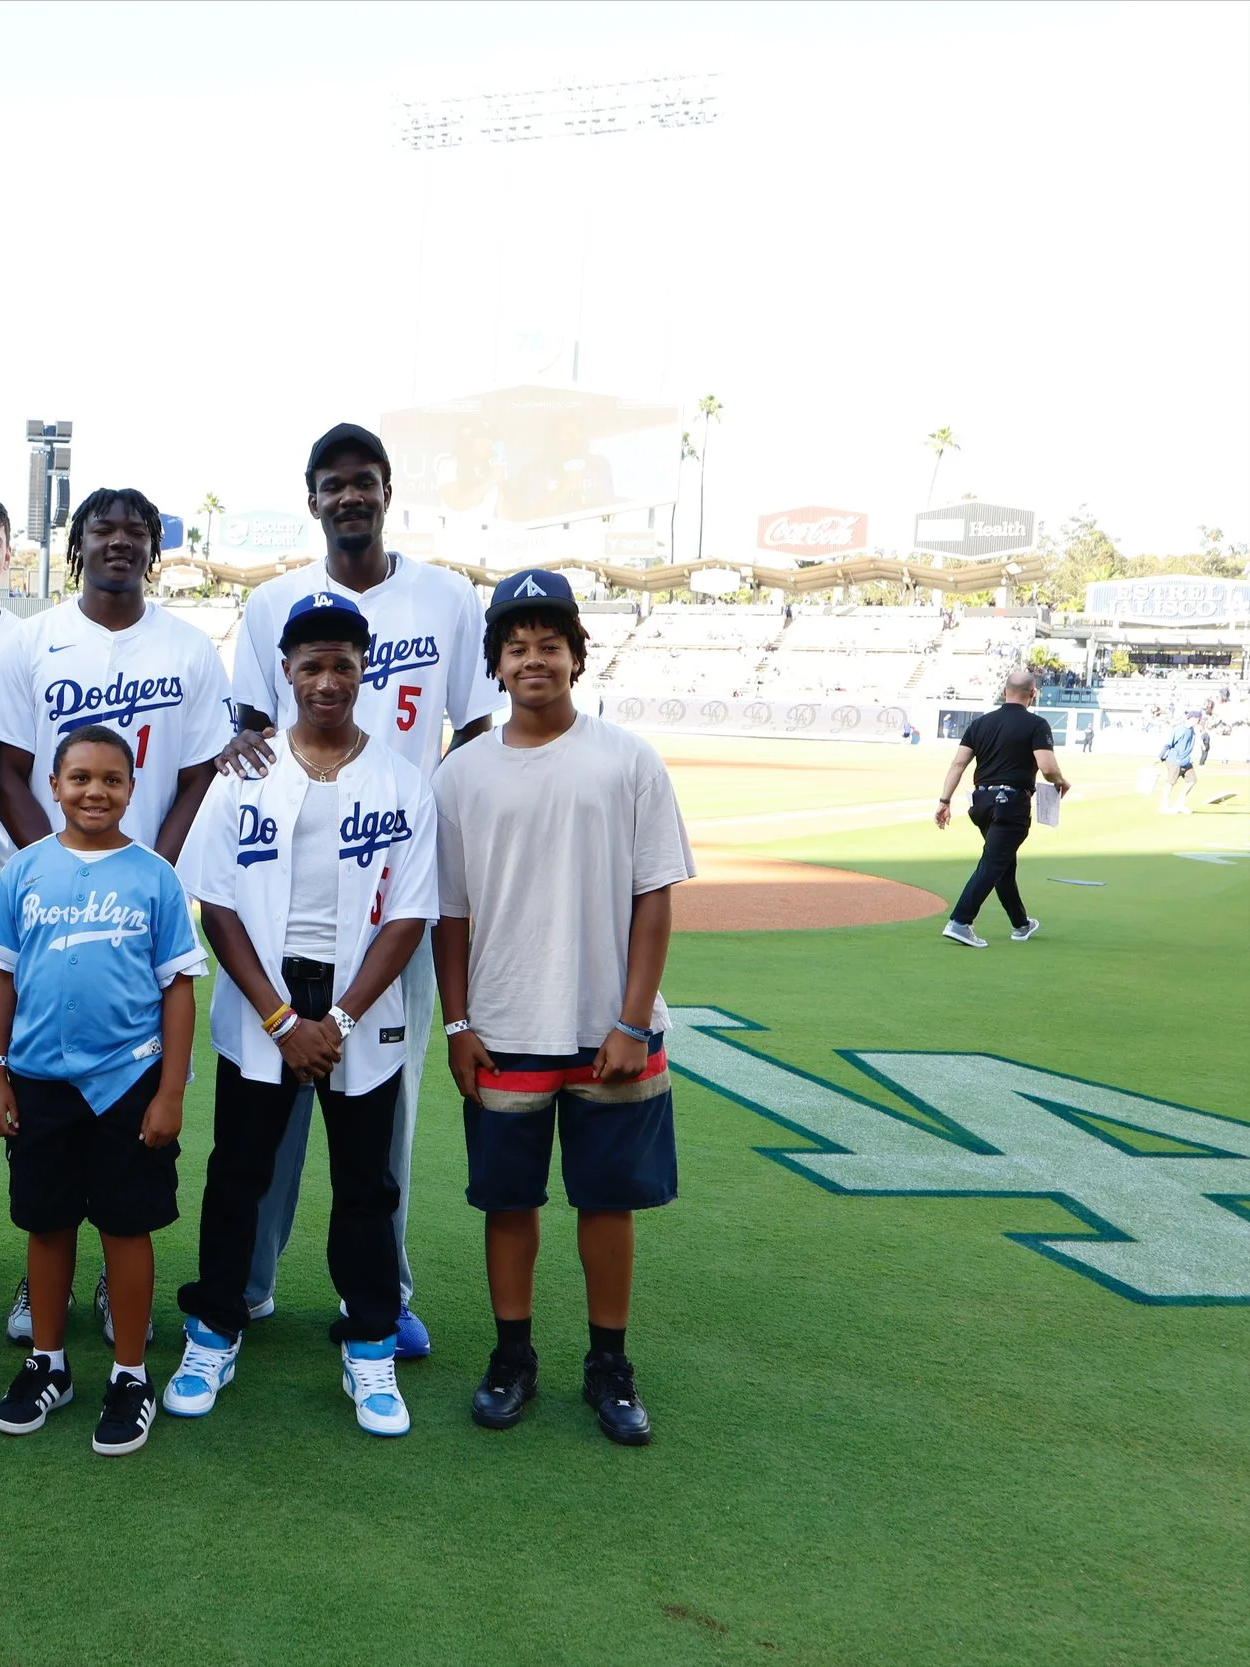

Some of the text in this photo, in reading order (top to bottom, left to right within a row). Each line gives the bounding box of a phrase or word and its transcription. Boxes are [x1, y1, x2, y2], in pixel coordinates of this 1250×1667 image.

[968, 520, 1027, 538] Health
[45, 672, 183, 728] Dodgers
[396, 685, 422, 732] 5
[135, 724, 151, 769] 1
[22, 890, 147, 947] Brooklyn
